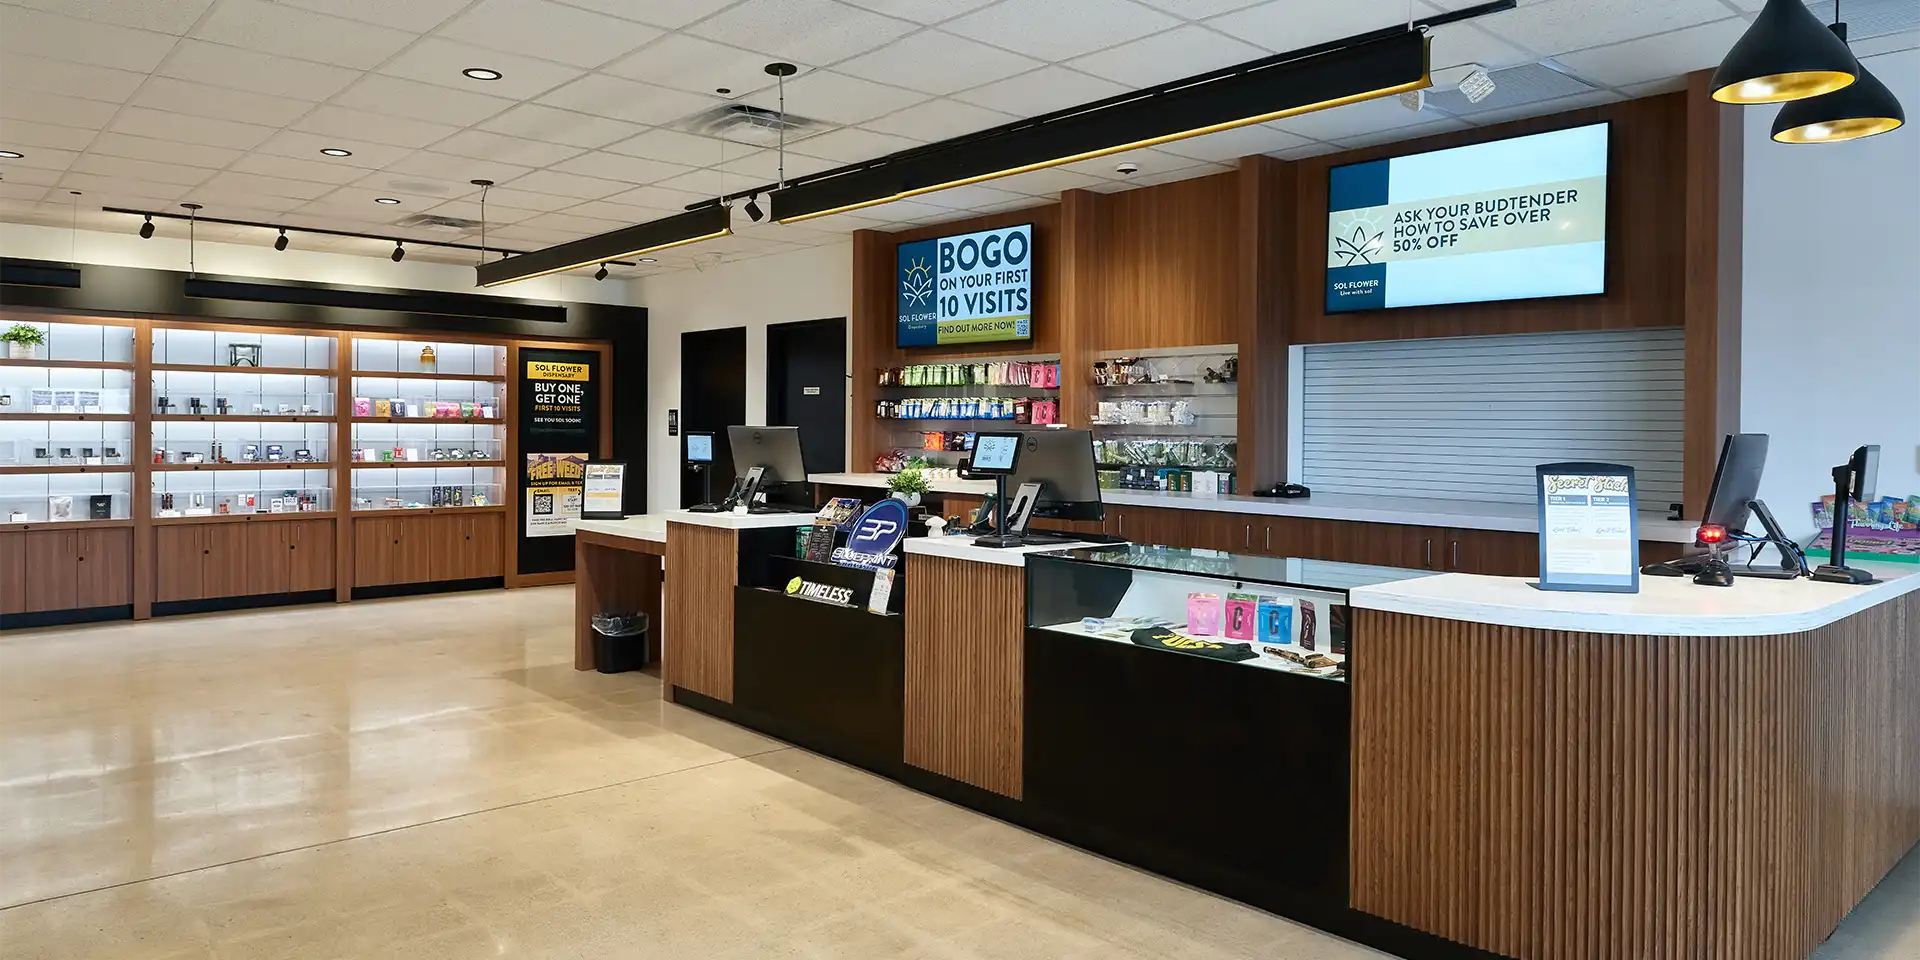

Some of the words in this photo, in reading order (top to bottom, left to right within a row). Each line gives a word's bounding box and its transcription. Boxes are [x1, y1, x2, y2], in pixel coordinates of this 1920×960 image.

[1393, 209, 1423, 224] ASK
[1426, 203, 1470, 220] YOUR
[1475, 189, 1578, 214] BUDTENDER
[1394, 222, 1431, 238] HOW
[1434, 220, 1455, 233] TO
[1459, 214, 1499, 231] SAVE
[1503, 208, 1551, 225] OVER
[939, 230, 1028, 274] BOGO
[1393, 237, 1422, 252] 50%
[1426, 233, 1459, 249] OFF
[939, 276, 957, 291] ON
[959, 273, 992, 289] YOUR
[995, 268, 1028, 285] FIRST
[1333, 282, 1348, 290] SOL
[1349, 279, 1379, 289] FLOWER
[939, 295, 959, 317] 10
[964, 287, 1028, 315] VISITS
[898, 315, 911, 323] SOL
[911, 312, 937, 322] FLOWER
[938, 325, 955, 334] FIND
[955, 324, 970, 333] OUT
[971, 322, 993, 332] MORE
[994, 321, 1015, 330] NOW!
[535, 364, 550, 372] SOL
[551, 364, 583, 373] FLOWER
[534, 382, 557, 393] BUY
[557, 383, 585, 397] ONE,
[535, 393, 557, 404] GET
[557, 394, 581, 404] ONE
[530, 460, 553, 481] FREE
[1547, 475, 1595, 494] Secret
[799, 581, 853, 604] TIMELESS
